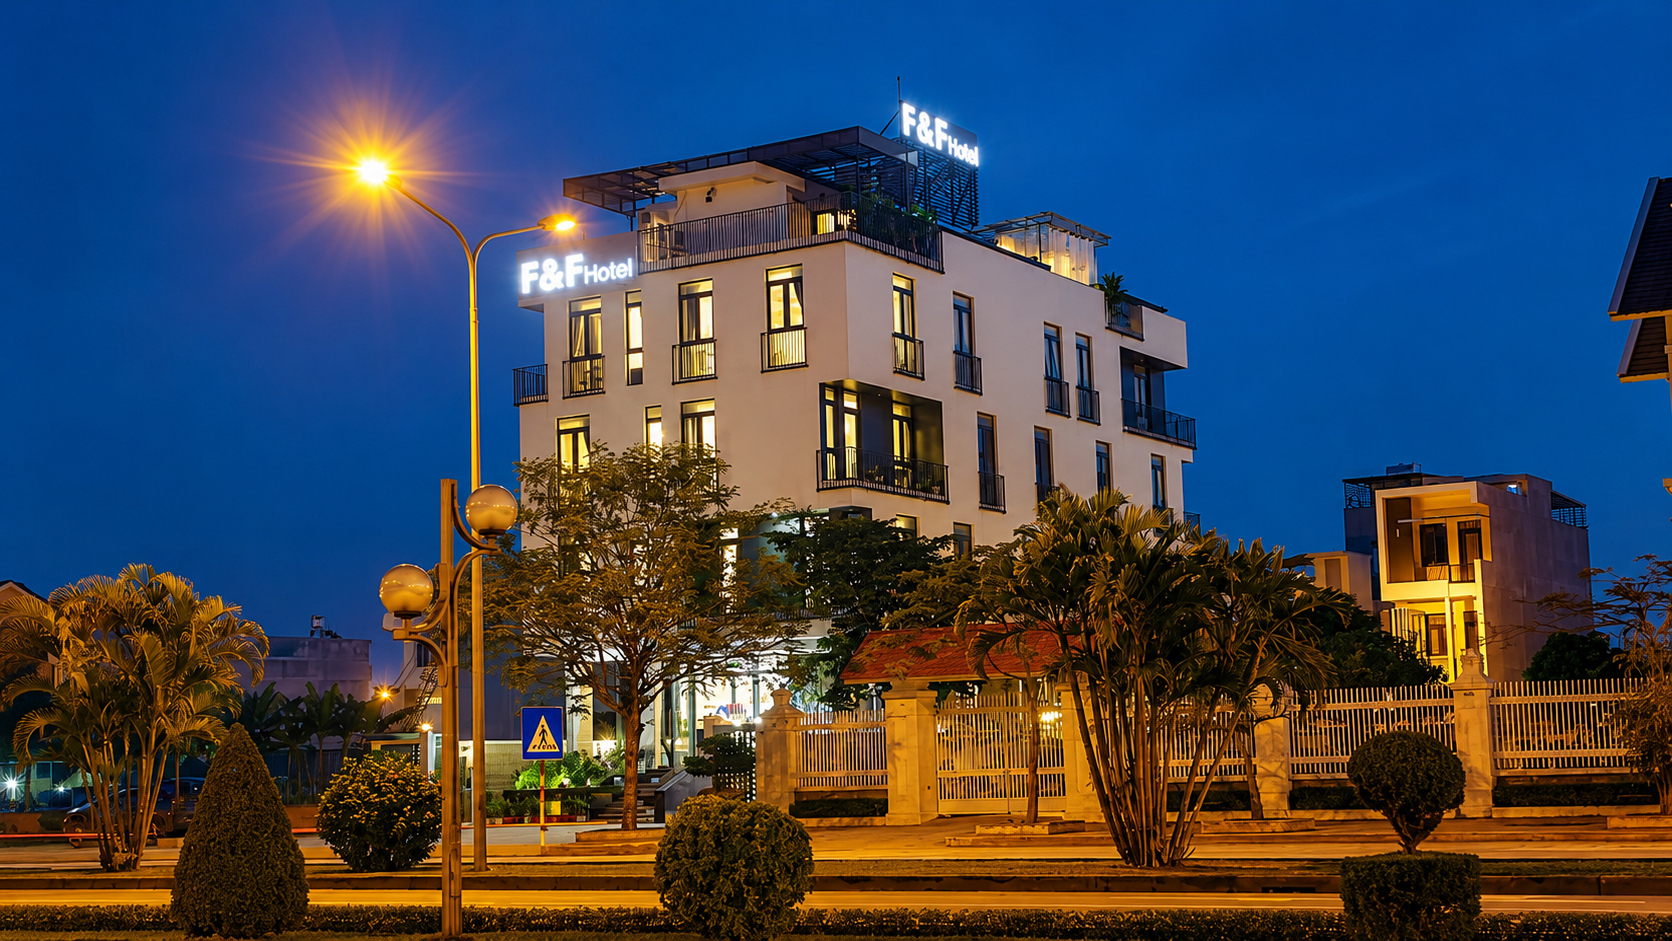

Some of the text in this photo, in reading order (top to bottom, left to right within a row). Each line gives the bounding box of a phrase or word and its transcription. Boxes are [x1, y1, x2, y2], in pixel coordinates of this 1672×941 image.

[902, 102, 979, 167] F&F Hotel
[521, 253, 633, 294] F&F Hotel
